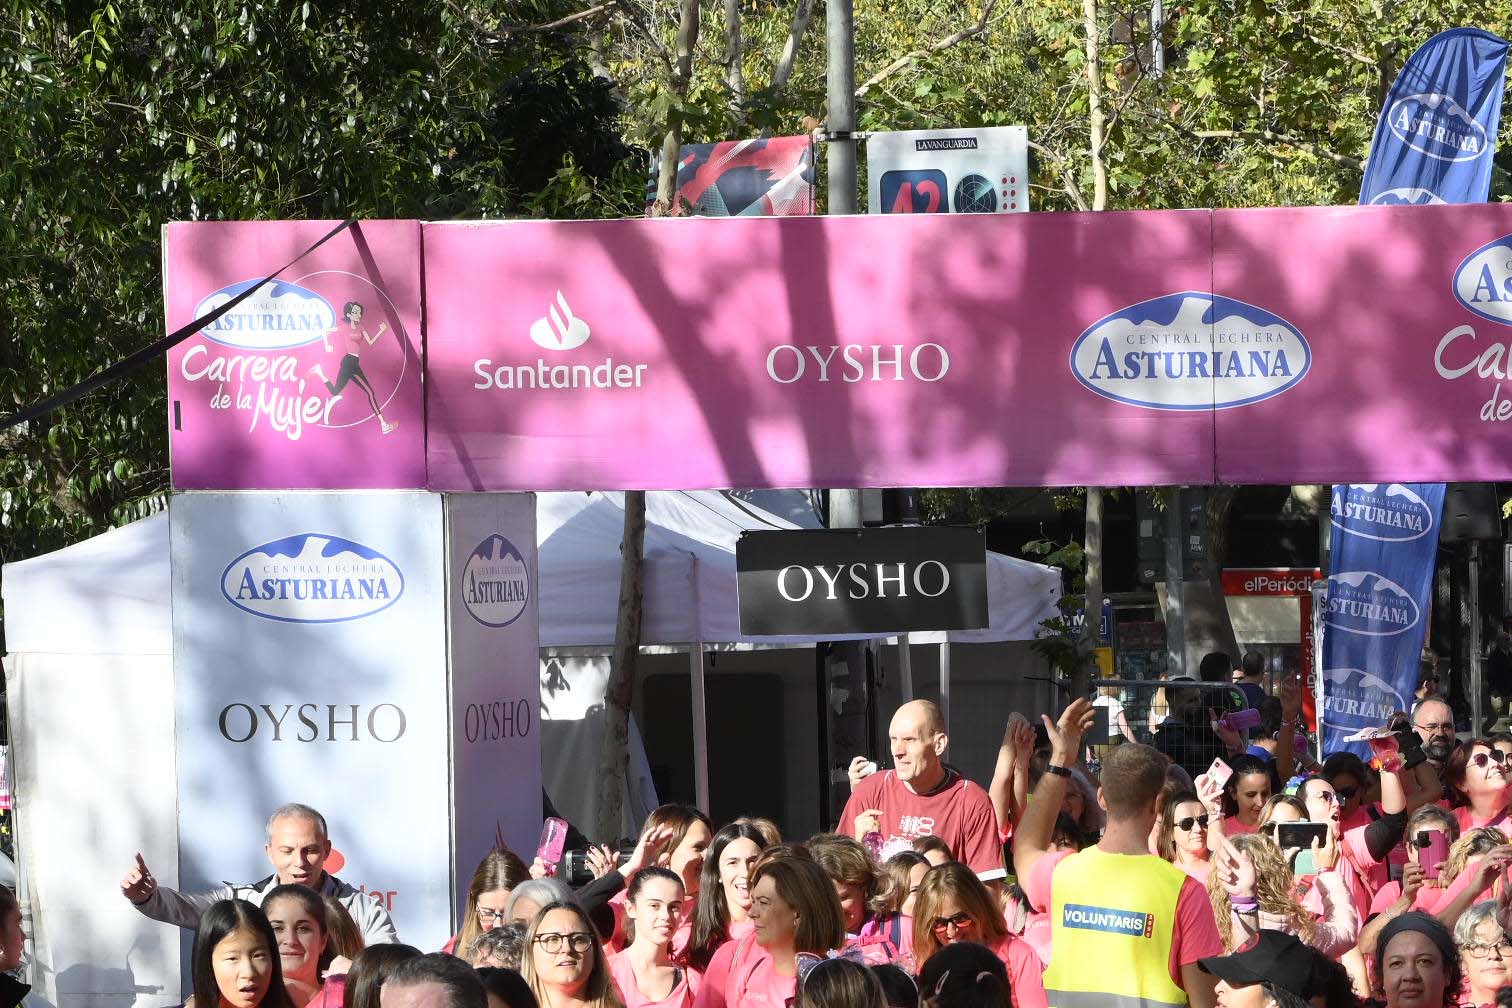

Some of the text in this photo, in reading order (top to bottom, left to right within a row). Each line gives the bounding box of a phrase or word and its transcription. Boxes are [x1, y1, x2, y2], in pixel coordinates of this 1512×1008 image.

[1394, 105, 1478, 153] ASTURIANA
[205, 305, 324, 331] ASTURIANA
[1126, 332, 1284, 345] CENTRAL LECHERA
[182, 345, 297, 382] Carrera
[474, 358, 648, 390] Santander
[767, 343, 950, 383] OYSHO
[1089, 337, 1293, 380] ASTURIANA
[210, 380, 343, 440] de la Mujer
[1331, 491, 1423, 532] ASTURIANA
[235, 567, 391, 601] ASTURIANA
[467, 569, 525, 604] ASTURIANA
[777, 560, 951, 602] OYSHO
[1245, 576, 1317, 592] elPeriódi
[1329, 597, 1409, 625] STURIANA
[218, 703, 407, 743] OYSHO
[465, 699, 531, 744] OYSHO
[1064, 909, 1143, 930] VOLUNTARIS
